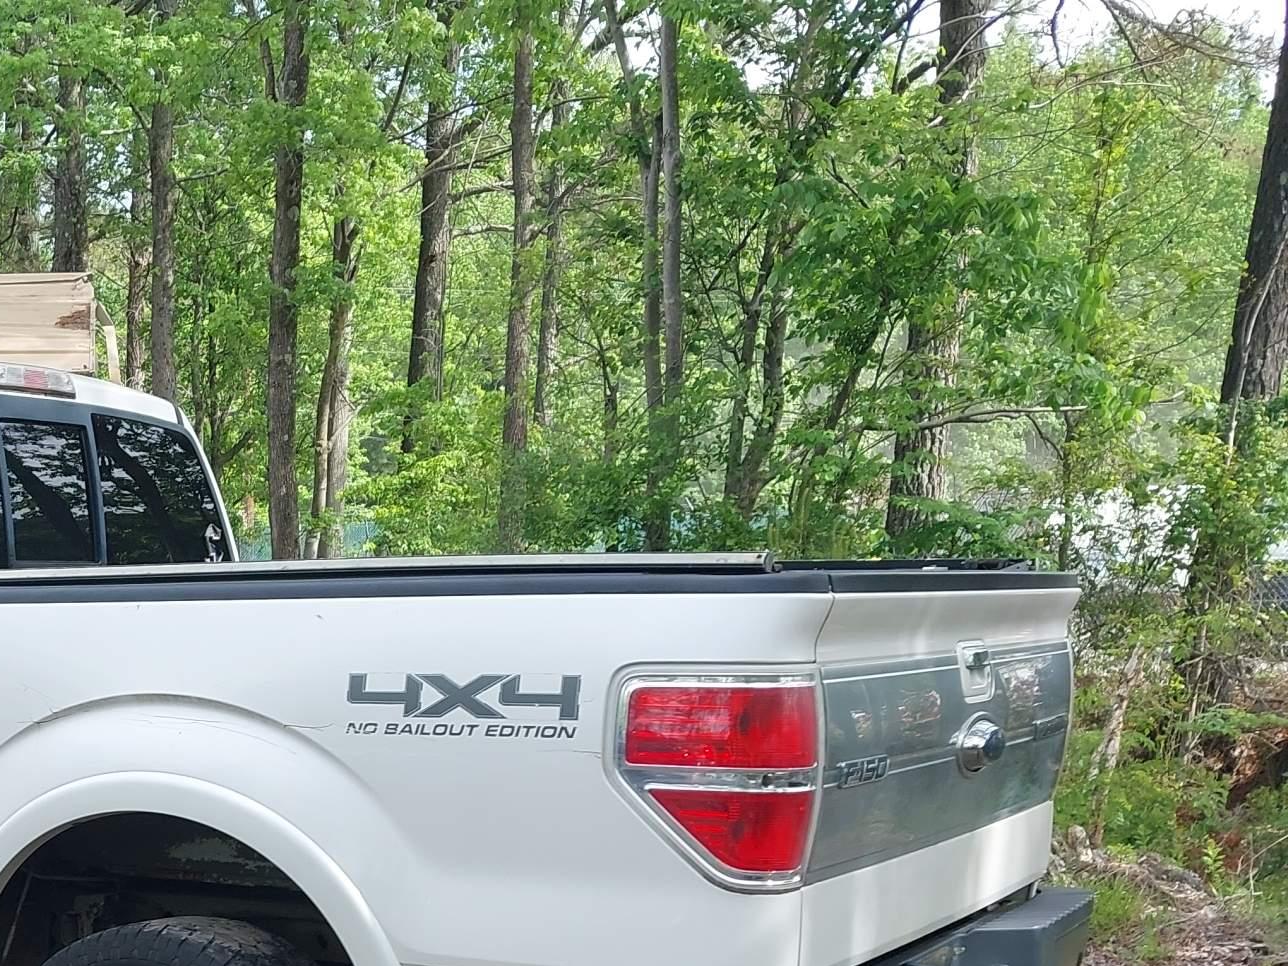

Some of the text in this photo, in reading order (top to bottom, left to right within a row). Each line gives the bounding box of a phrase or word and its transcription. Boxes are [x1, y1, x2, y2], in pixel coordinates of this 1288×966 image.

[345, 722, 577, 739] NO BAILOUT EDITION
